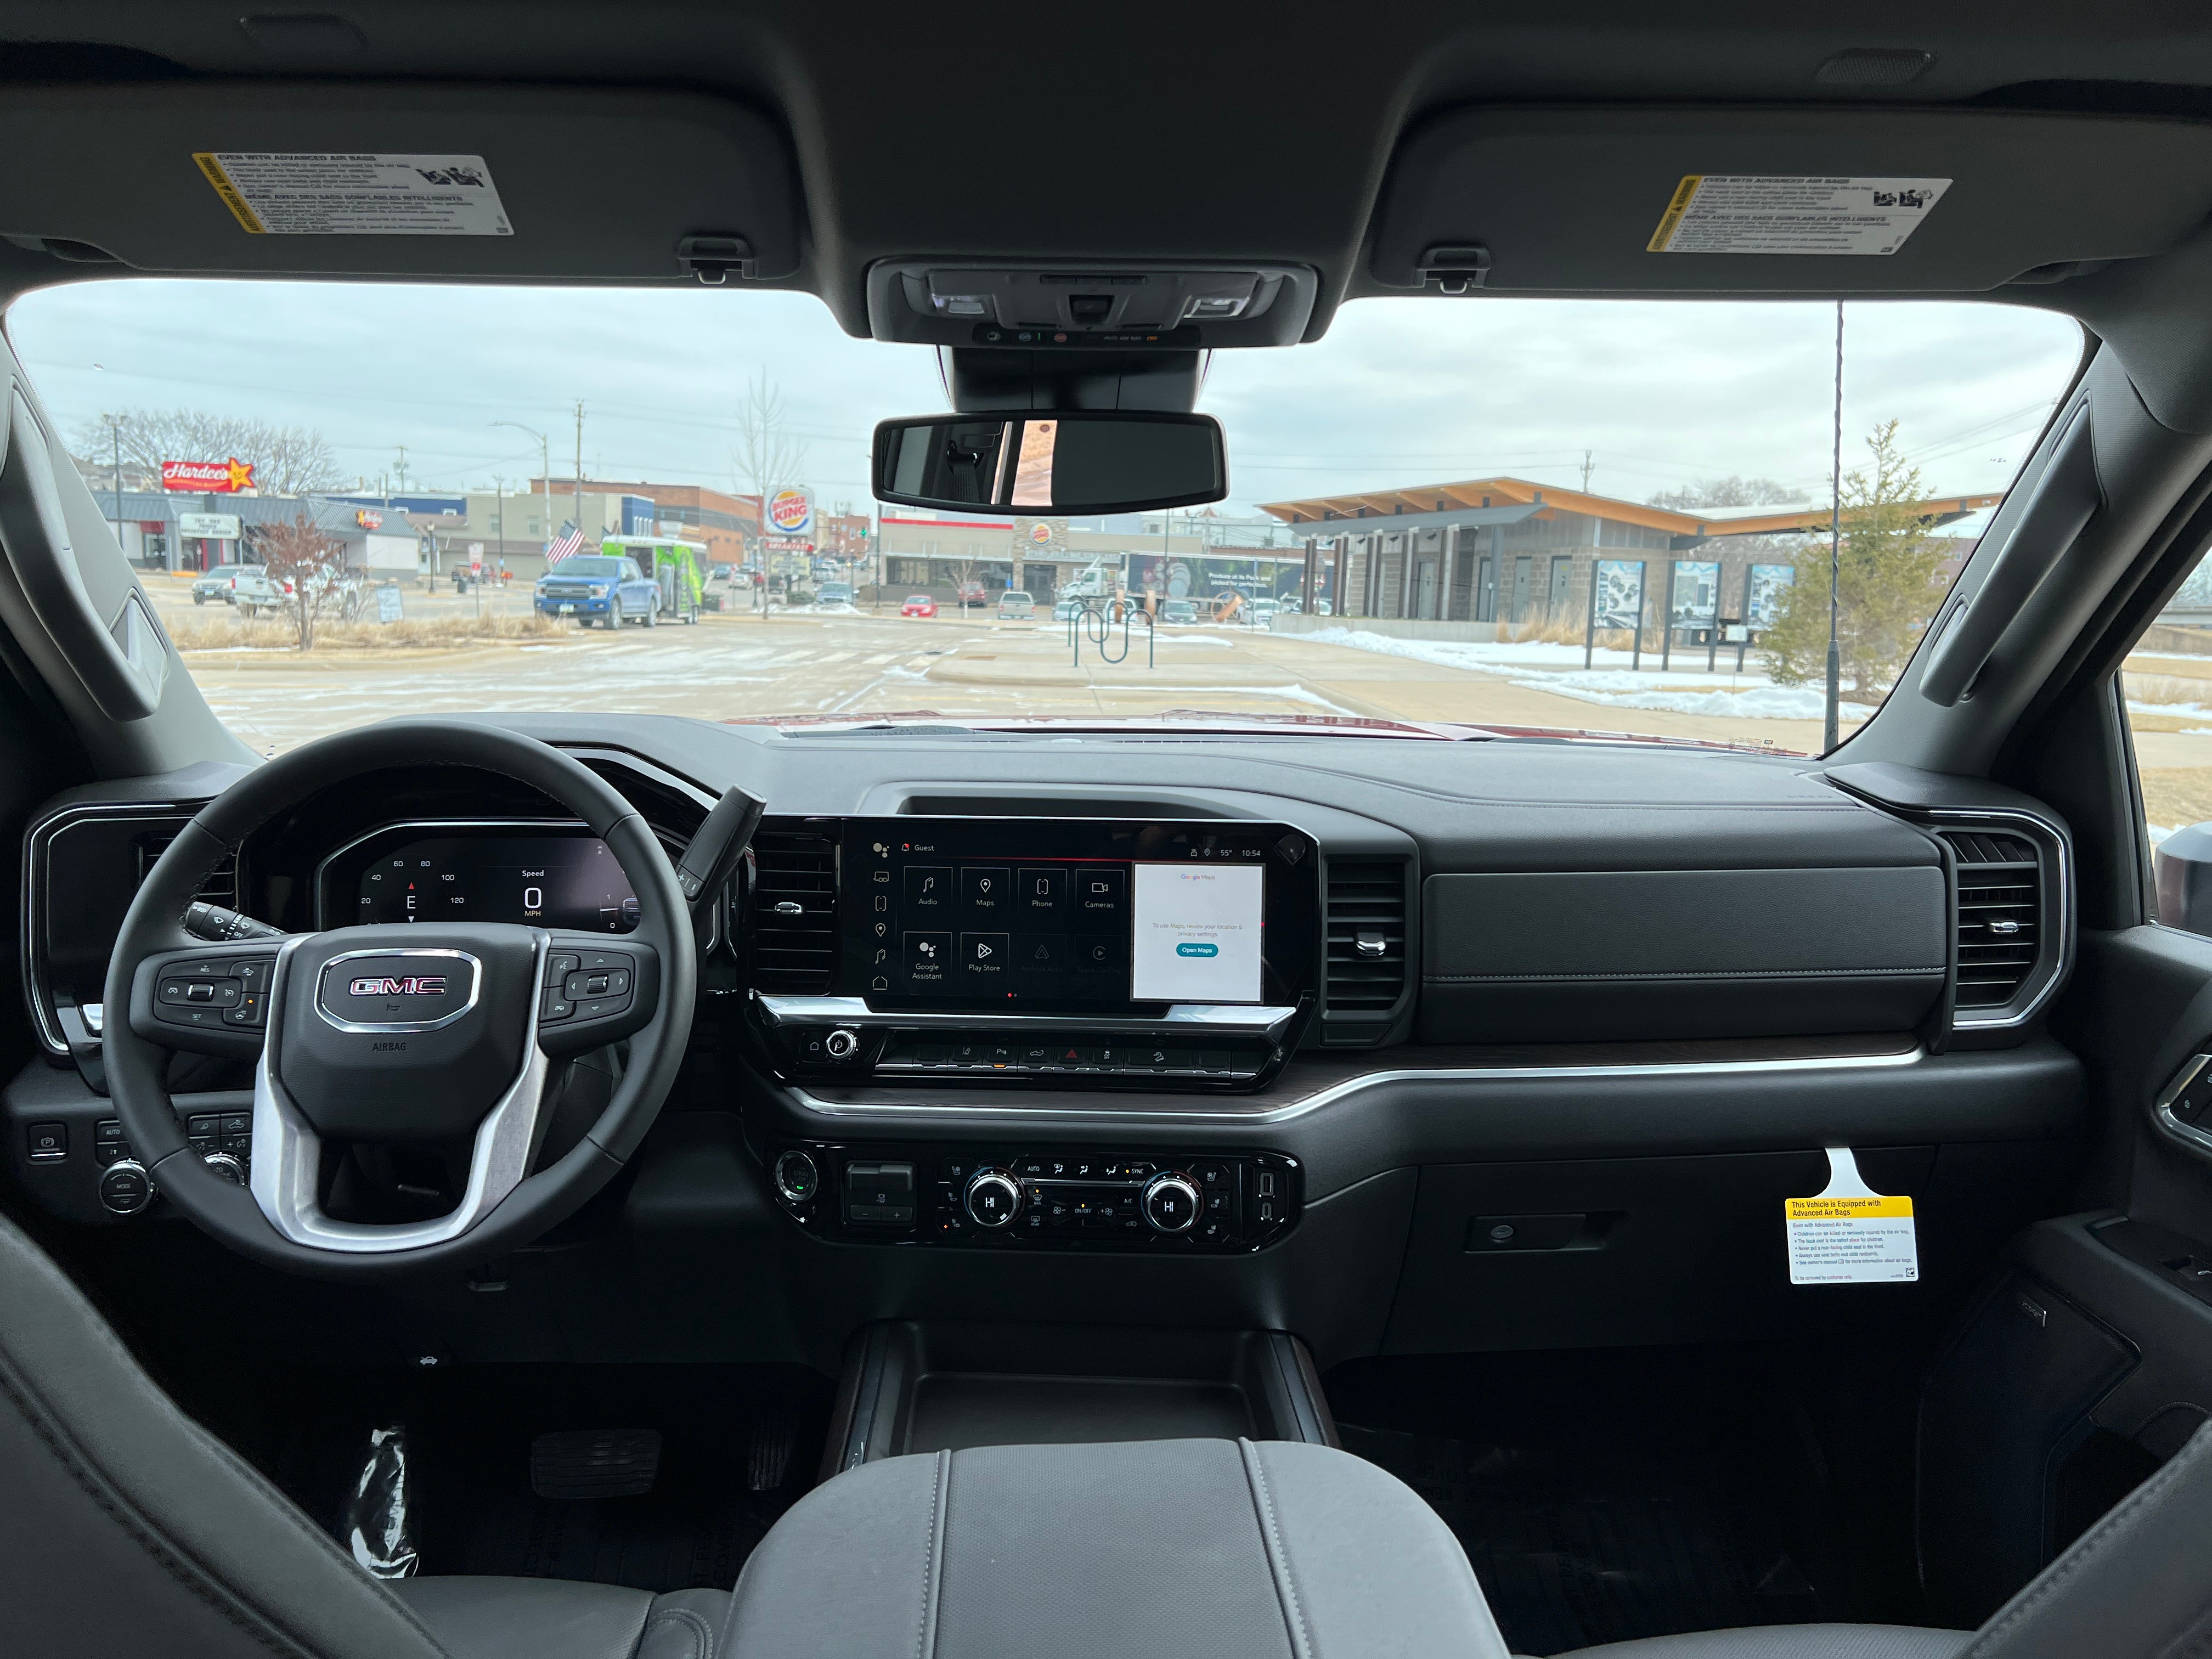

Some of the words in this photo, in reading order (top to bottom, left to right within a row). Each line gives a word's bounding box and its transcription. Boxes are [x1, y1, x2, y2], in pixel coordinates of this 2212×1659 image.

[163, 464, 228, 480] Hardee's
[772, 496, 806, 510] BURGER
[774, 505, 808, 522] KING
[407, 896, 416, 909] E
[524, 888, 542, 909] 0
[969, 964, 983, 973] Play
[349, 976, 447, 996] GMC
[373, 1042, 407, 1052] AIRBAG
[985, 1197, 995, 1207] HI
[1164, 1201, 1173, 1212] HI
